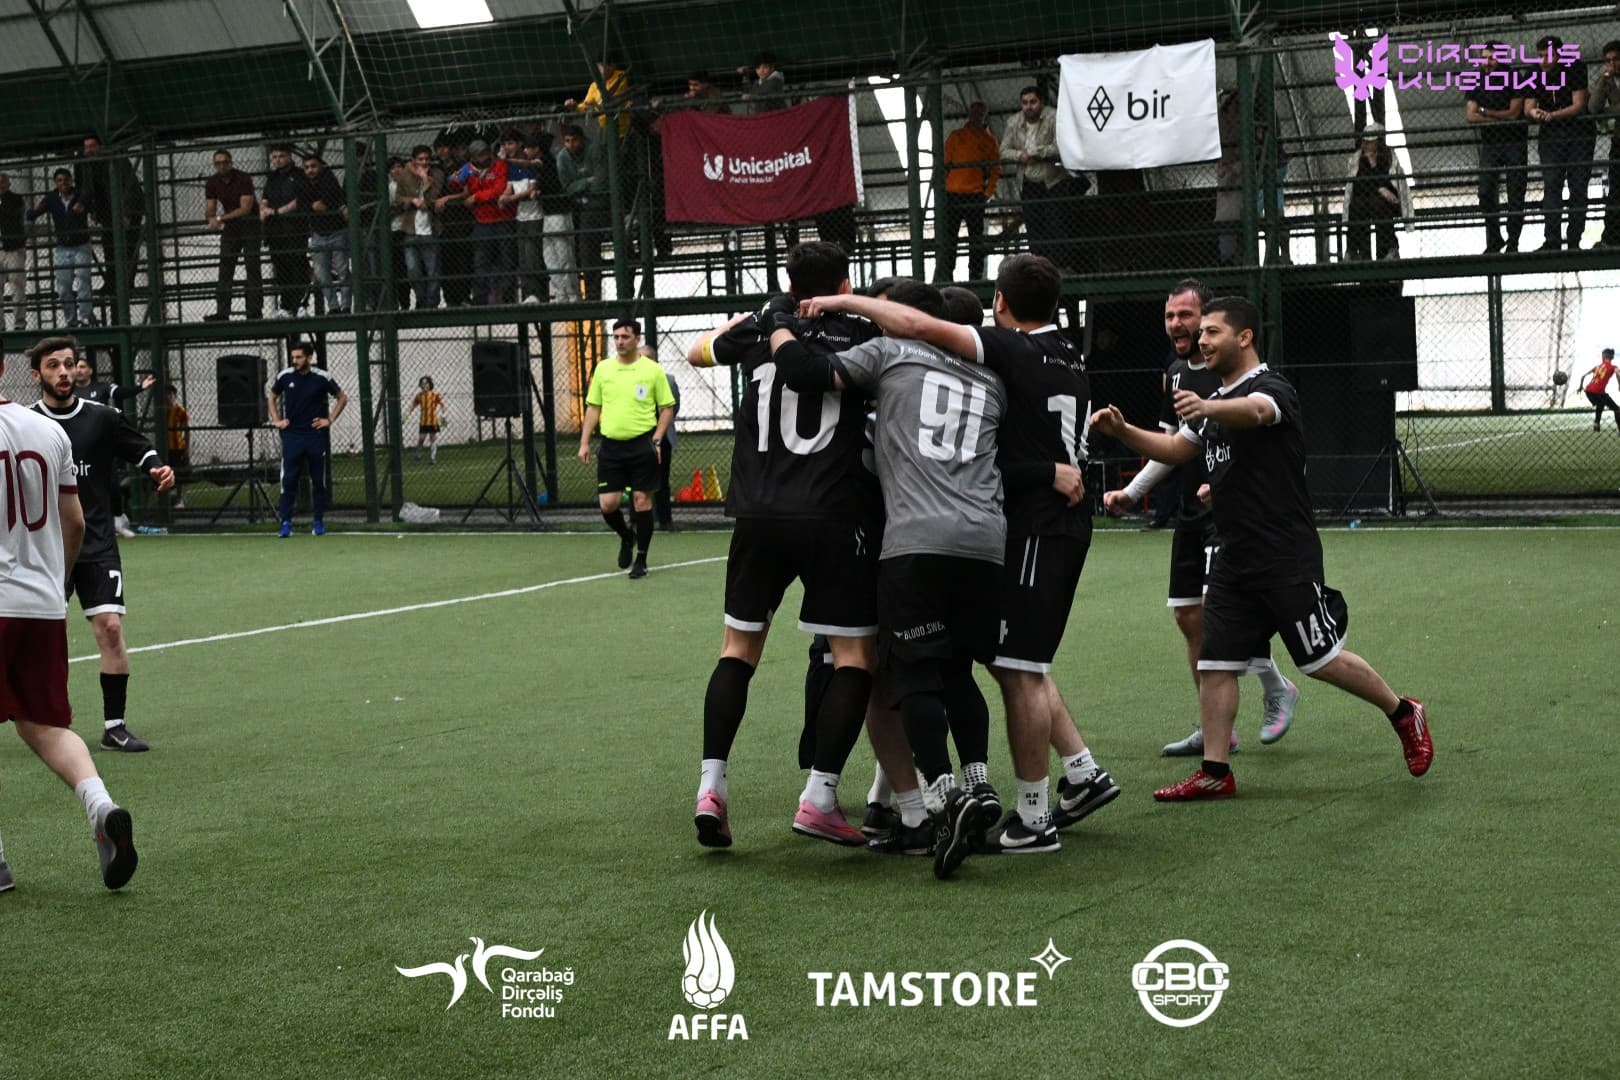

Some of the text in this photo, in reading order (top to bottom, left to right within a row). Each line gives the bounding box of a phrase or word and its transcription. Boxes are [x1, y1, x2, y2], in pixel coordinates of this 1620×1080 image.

[1127, 89, 1171, 121] bir
[728, 146, 812, 176] Unicapital
[751, 362, 842, 455] 10
[918, 370, 986, 463] 91
[0, 450, 48, 533] 10
[109, 569, 122, 597] 7
[1295, 613, 1326, 656] 14
